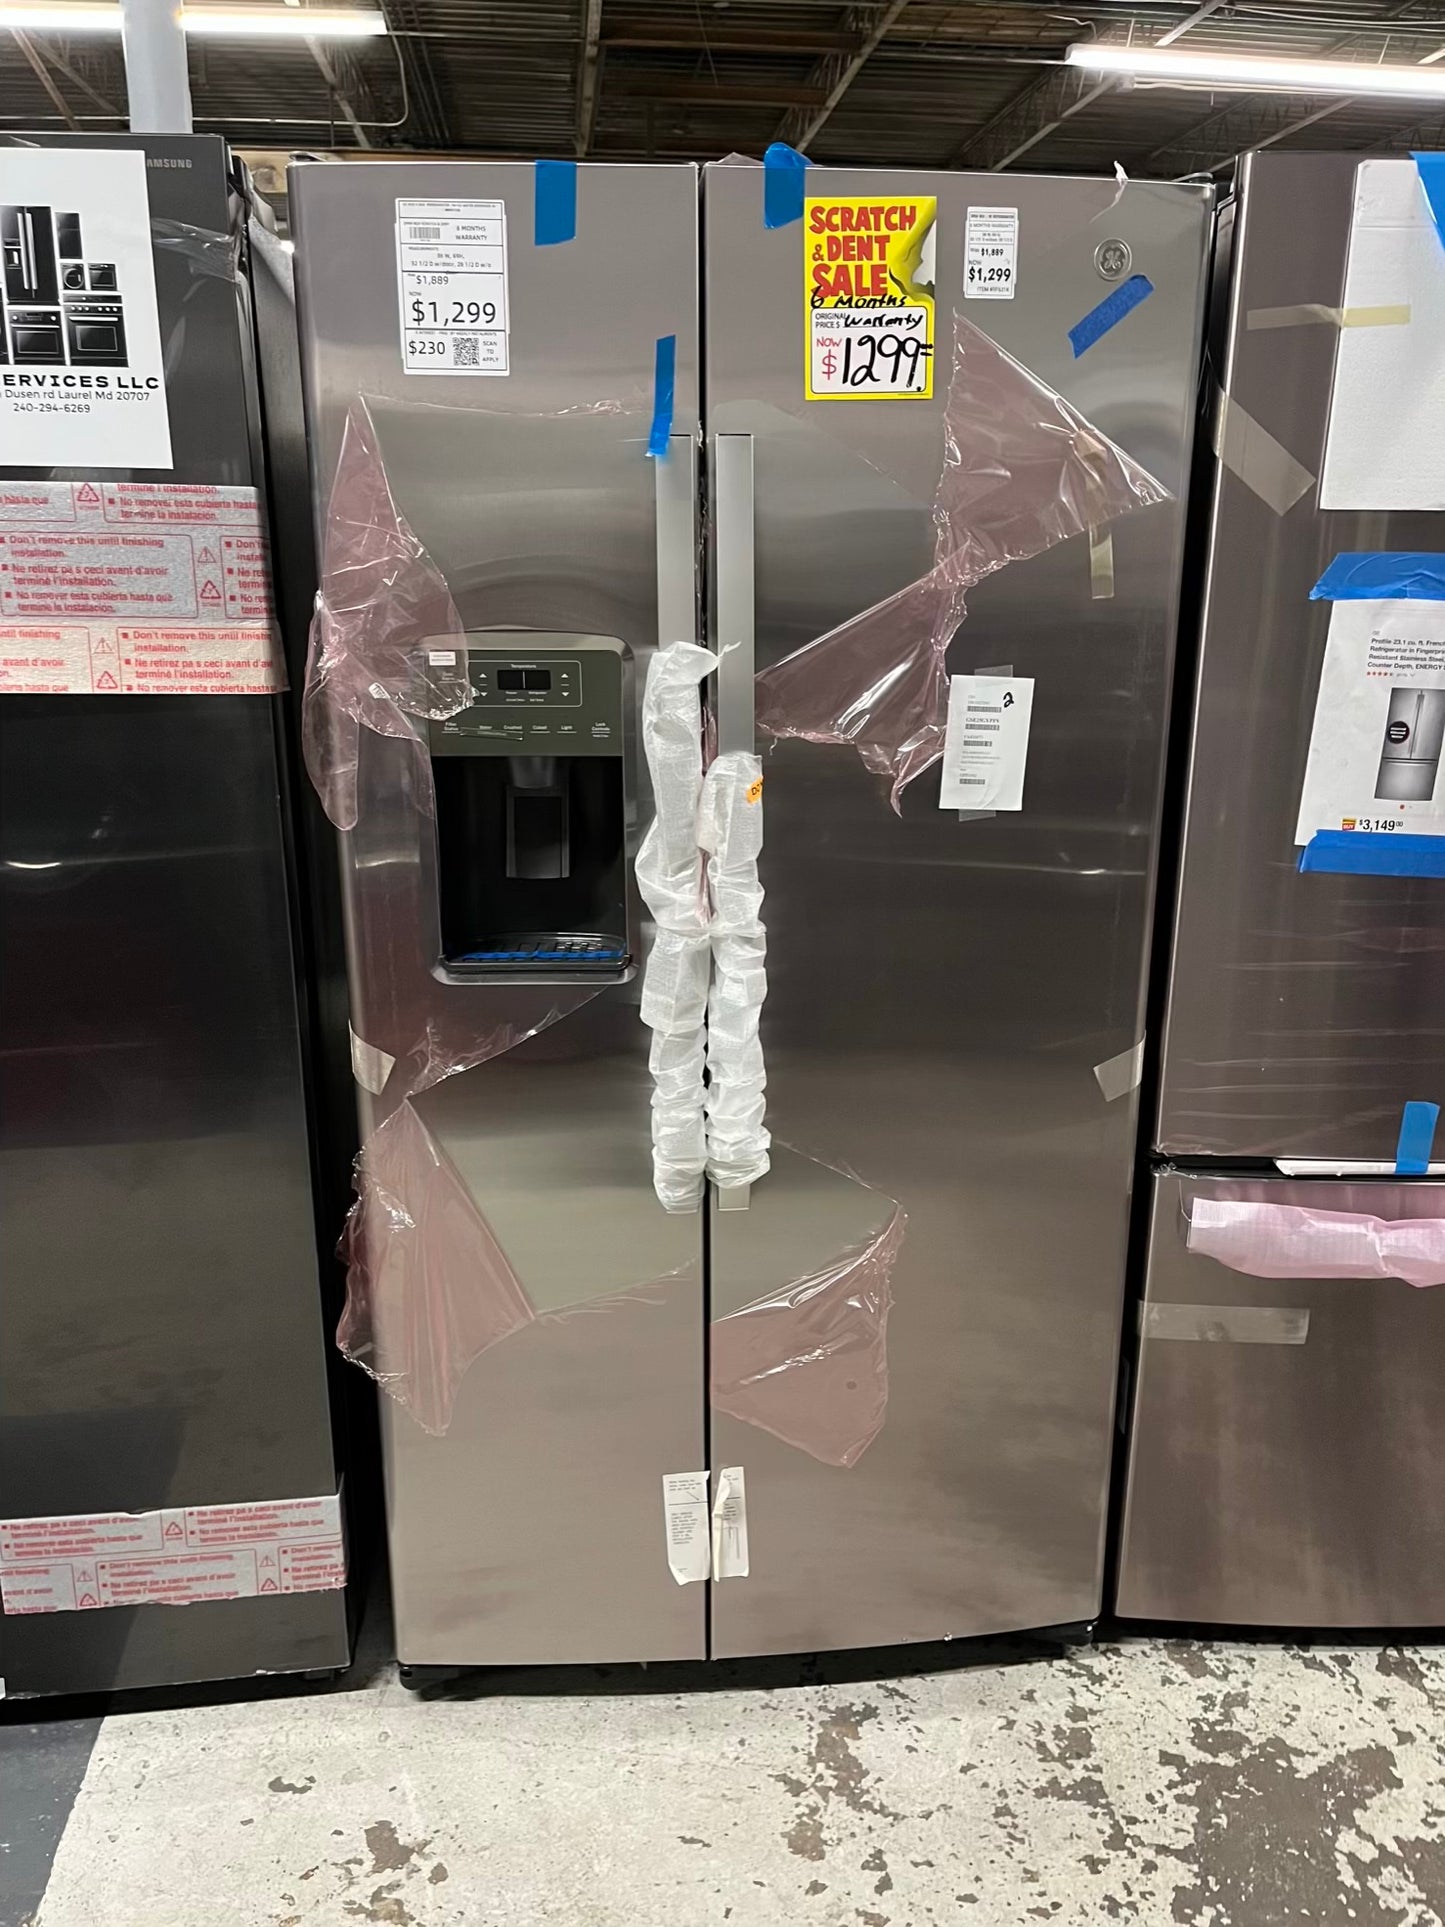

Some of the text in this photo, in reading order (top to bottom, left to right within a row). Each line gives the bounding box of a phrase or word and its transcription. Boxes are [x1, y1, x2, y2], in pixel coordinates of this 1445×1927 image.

[810, 206, 916, 234] SCRATCH
[812, 235, 890, 262] & DENT
[981, 248, 1004, 256] $1,889
[968, 266, 1012, 282] $1,299
[416, 275, 448, 286] $1,889
[811, 263, 888, 298] SALE
[810, 285, 907, 309] 6 Months
[412, 298, 496, 326] $1,299
[408, 340, 446, 356] $230
[816, 337, 843, 348] NOW
[116, 376, 160, 390] LLC
[4, 389, 150, 401] Dusen rd Laurel Md 20707
[13, 402, 91, 413] 240-294-6269
[9, 536, 36, 544] Don't
[122, 538, 164, 548] finishing
[12, 564, 26, 573] Ne
[28, 564, 58, 573] retirez
[84, 566, 104, 574] ceci
[106, 566, 133, 574] avant
[135, 566, 168, 576] d'avoir
[17, 592, 30, 600] No
[92, 592, 128, 600] cubierta
[19, 631, 61, 640] finishing
[133, 631, 159, 640] Don't
[161, 632, 196, 640] remove
[198, 632, 216, 640] this
[134, 644, 190, 652] installation.
[135, 659, 148, 668] Ne
[150, 660, 179, 668] retirez
[182, 660, 193, 670] pa
[204, 660, 222, 668] ceci
[226, 660, 250, 668] avant
[174, 670, 234, 680] l'installation.
[152, 684, 187, 692] remover
[210, 684, 244, 692] cubierta
[1002, 692, 1014, 708] 2
